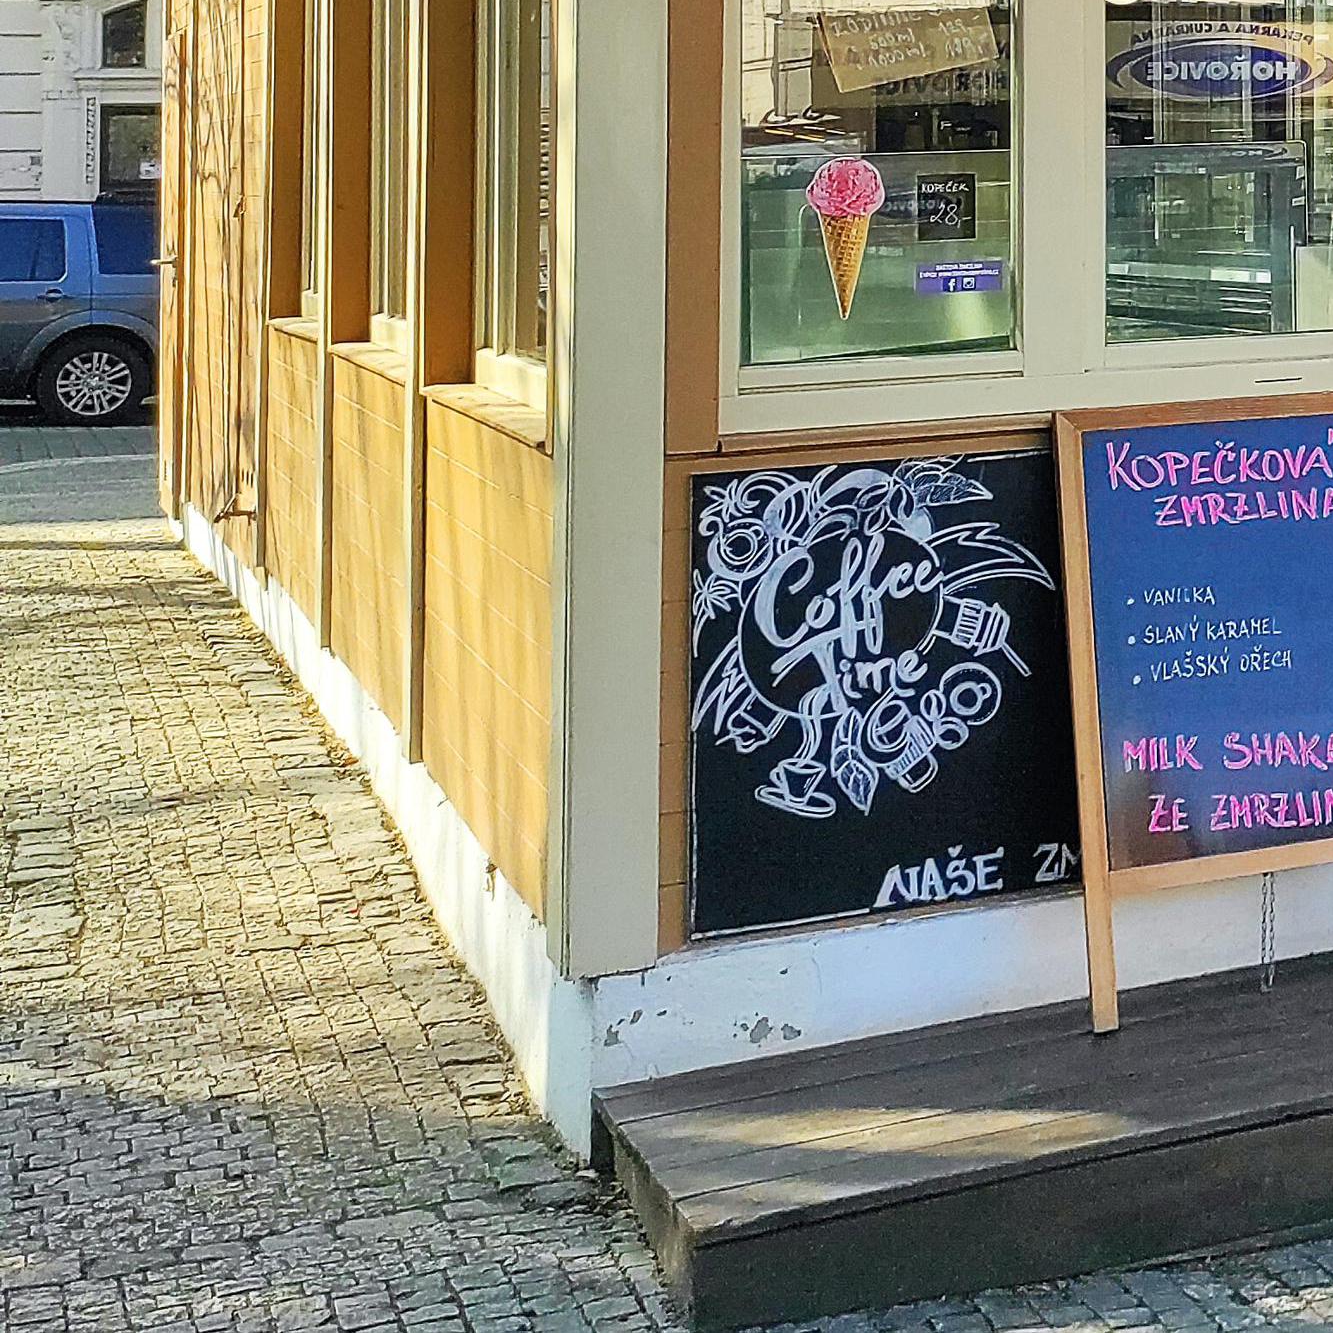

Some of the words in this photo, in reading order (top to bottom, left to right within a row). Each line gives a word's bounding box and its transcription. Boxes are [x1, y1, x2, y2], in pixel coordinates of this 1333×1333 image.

[921, 180, 969, 194] KOPEČEK
[754, 537, 944, 654] Coffee
[1143, 586, 1216, 606] VANILKA
[1143, 616, 1200, 644] SLANÝ
[1205, 618, 1282, 641] KARAMEL
[769, 627, 931, 719] Time
[1150, 648, 1230, 683] VLAŠSKÝ
[1239, 647, 1292, 671] OŘECH
[1123, 735, 1203, 772] MILK
[1149, 794, 1187, 833] ZE
[872, 844, 1005, 908] NAŠE
